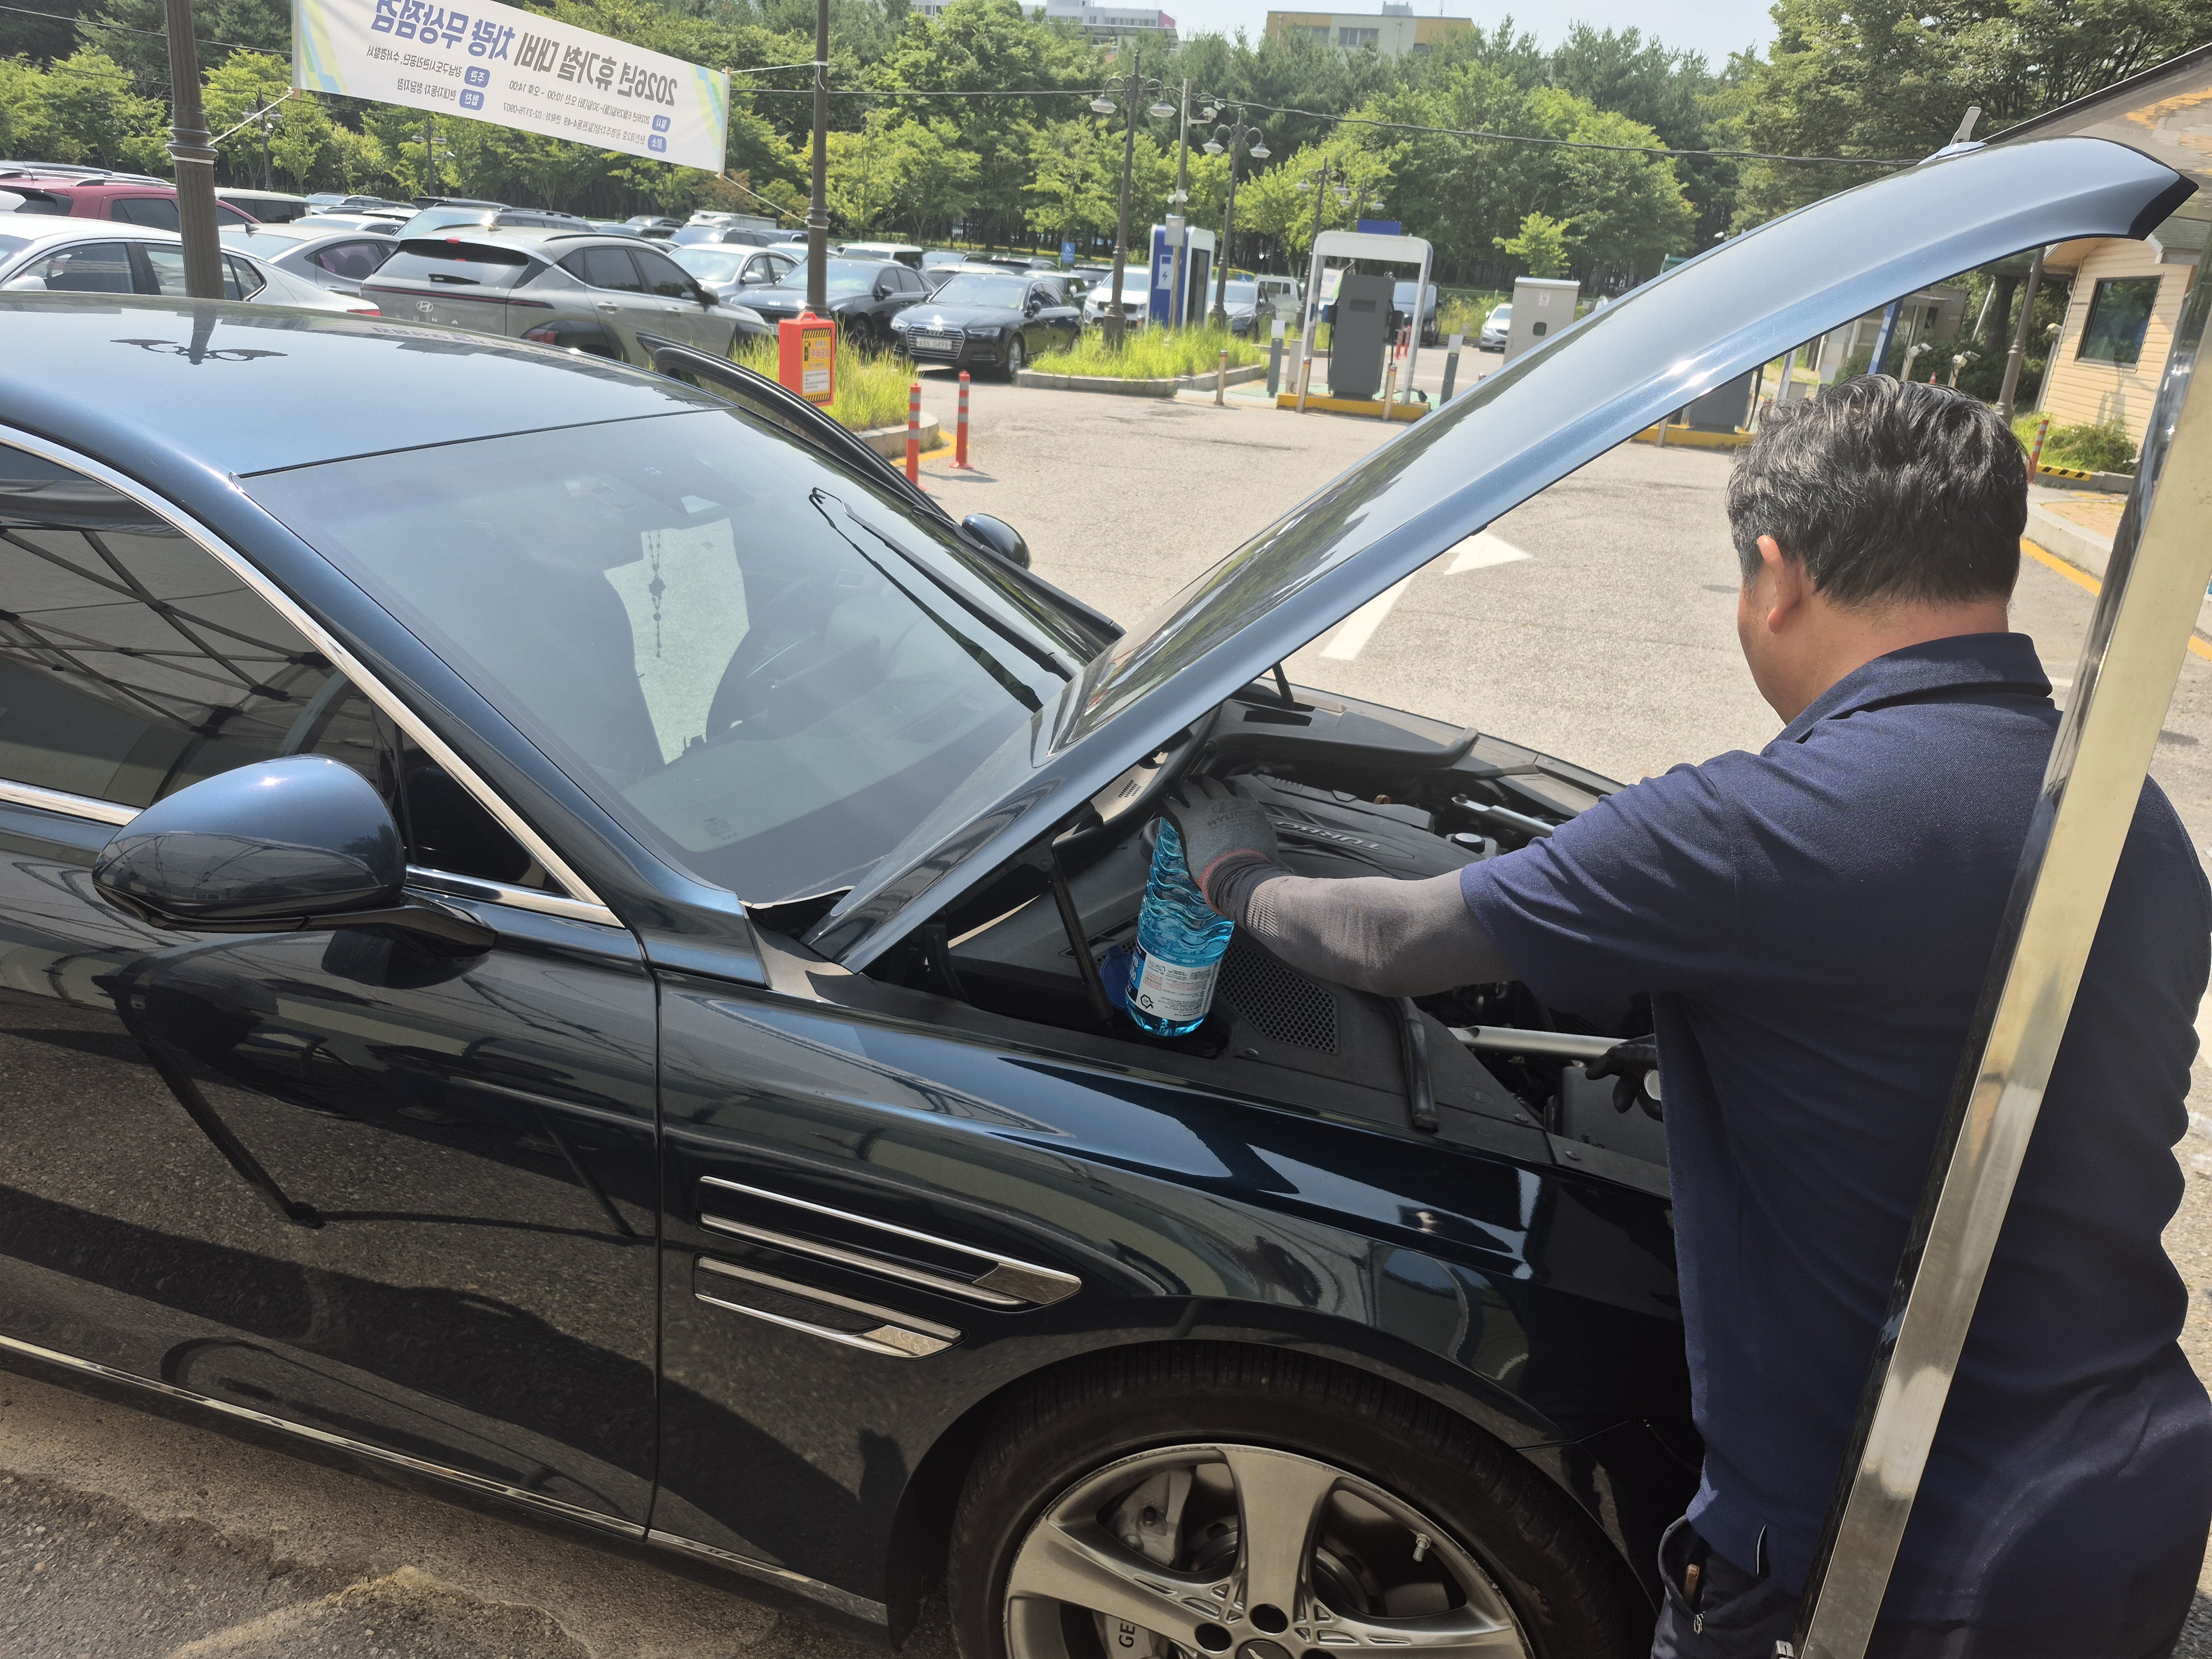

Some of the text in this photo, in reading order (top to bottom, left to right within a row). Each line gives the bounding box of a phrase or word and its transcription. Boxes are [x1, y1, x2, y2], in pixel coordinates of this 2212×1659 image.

[396, 314, 458, 325] KONA
[811, 348, 830, 359] 주차금지
[1275, 822, 1380, 851] TURBO
[1119, 1621, 1135, 1648] GE
